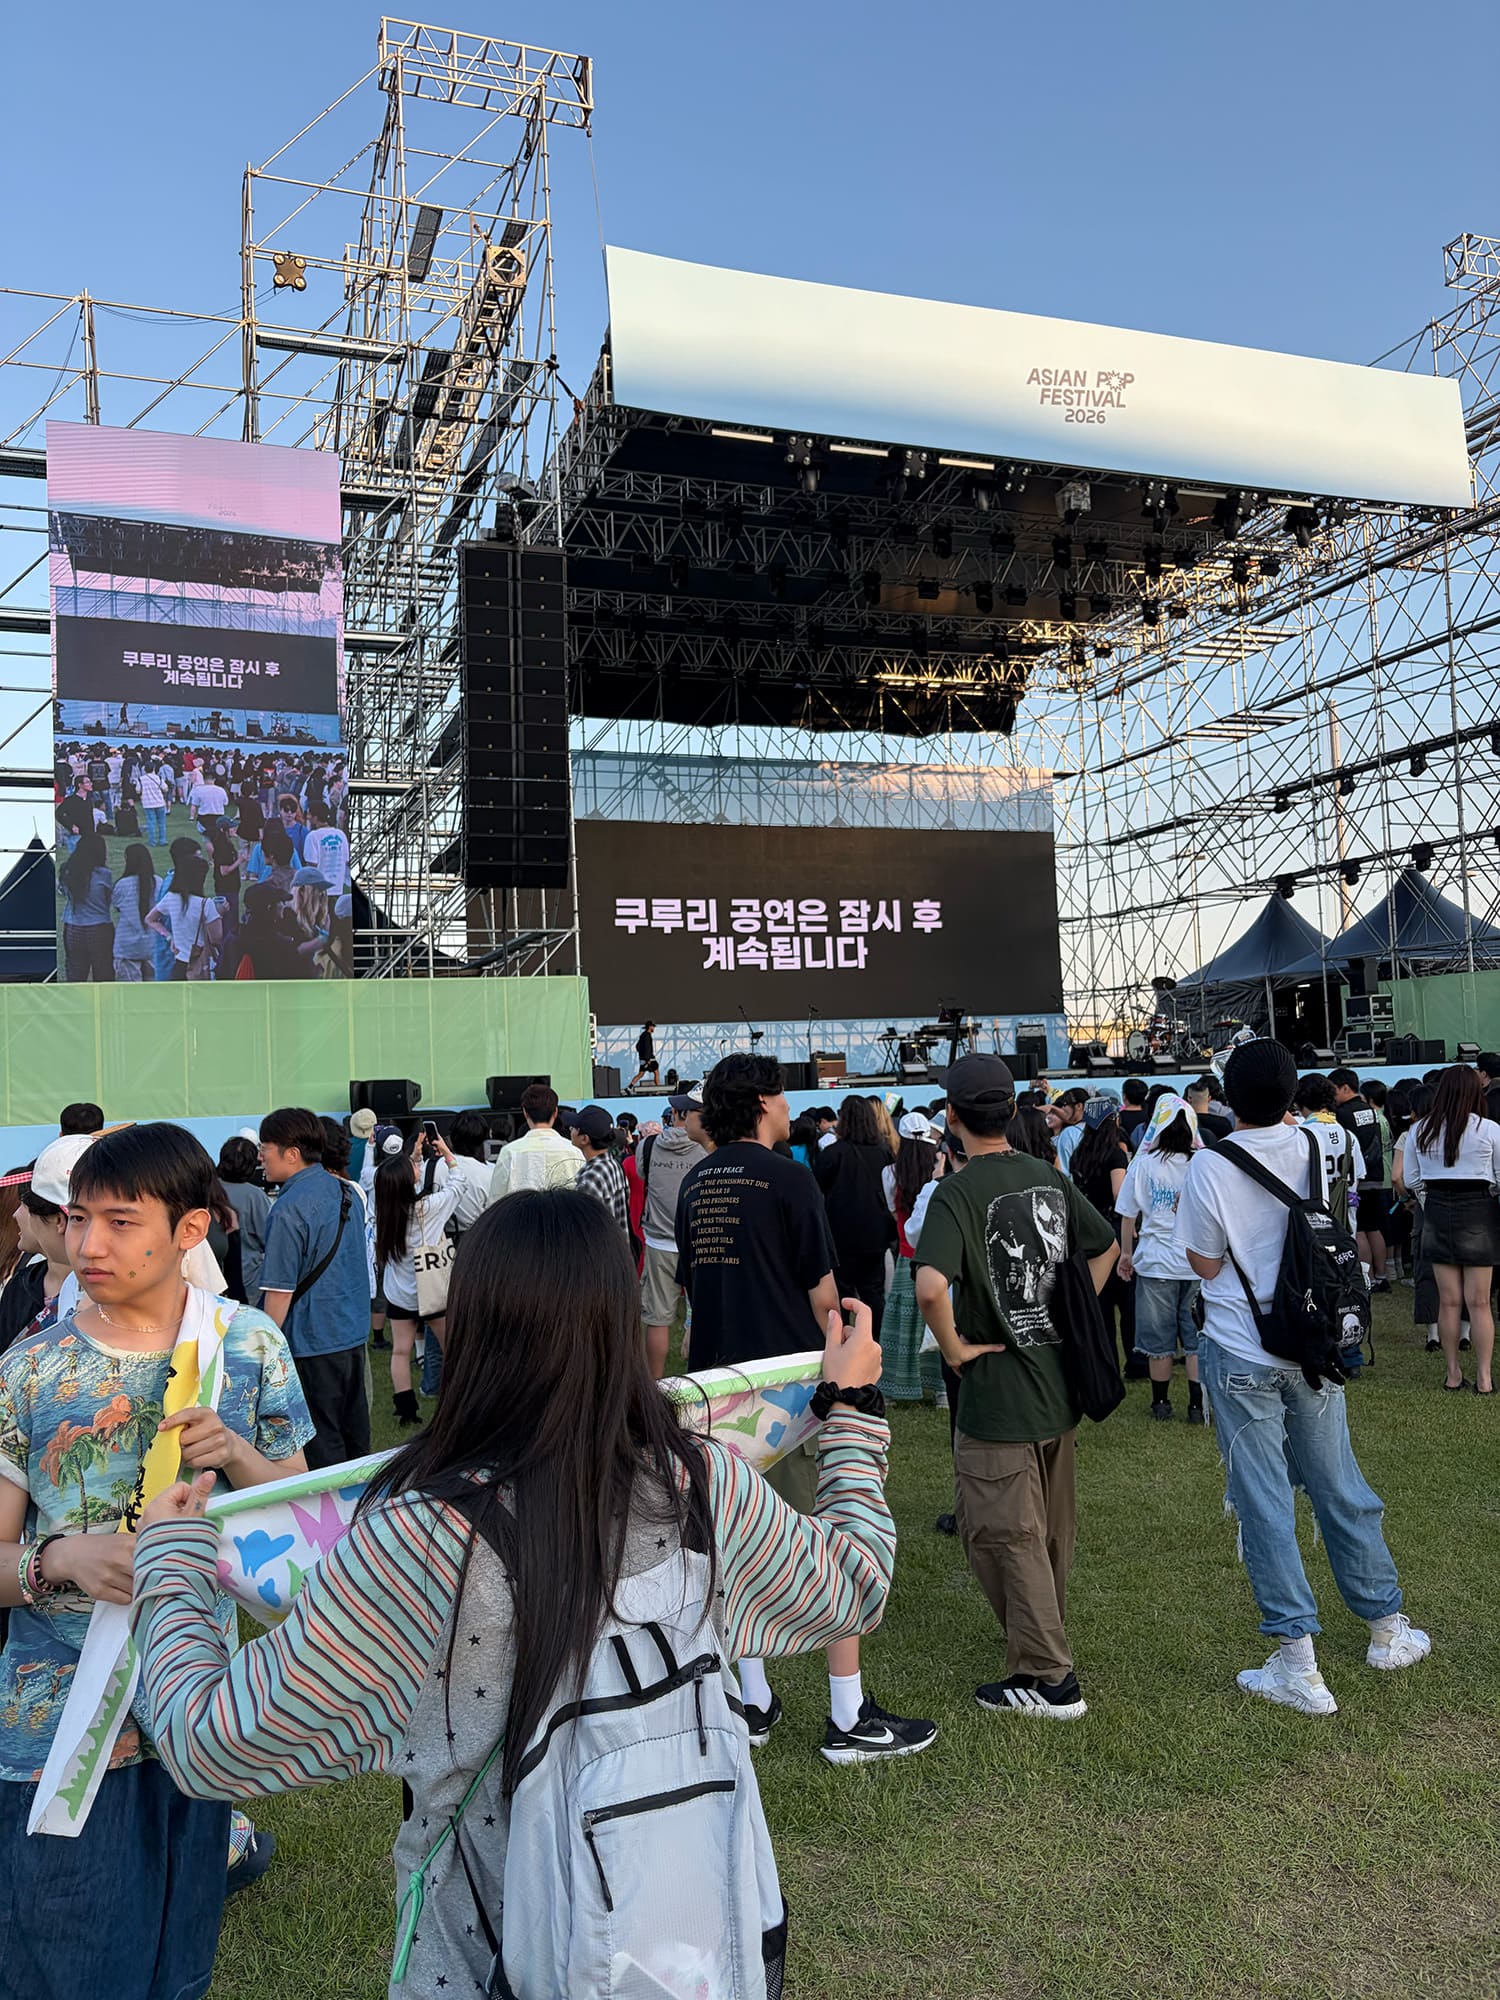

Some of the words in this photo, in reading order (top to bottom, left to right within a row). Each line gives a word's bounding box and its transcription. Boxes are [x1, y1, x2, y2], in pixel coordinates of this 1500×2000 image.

[1026, 368, 1087, 387] ASIAN
[1096, 370, 1135, 392] POP
[1040, 388, 1126, 408] FESTIVAL
[1065, 409, 1106, 424] 2026
[122, 651, 172, 669] 쿠루리
[177, 655, 225, 673] 공연은
[229, 659, 260, 675] 잠시
[265, 661, 281, 677] 후
[163, 669, 243, 689] 계속됩니다
[615, 899, 718, 934] 쿠루리
[730, 899, 828, 933] 공연은
[839, 899, 901, 933] 잠시
[912, 900, 942, 933] 후
[702, 936, 868, 971] 계속됩니다
[722, 1166, 744, 1174] PEACE
[755, 1180, 770, 1190] DUE
